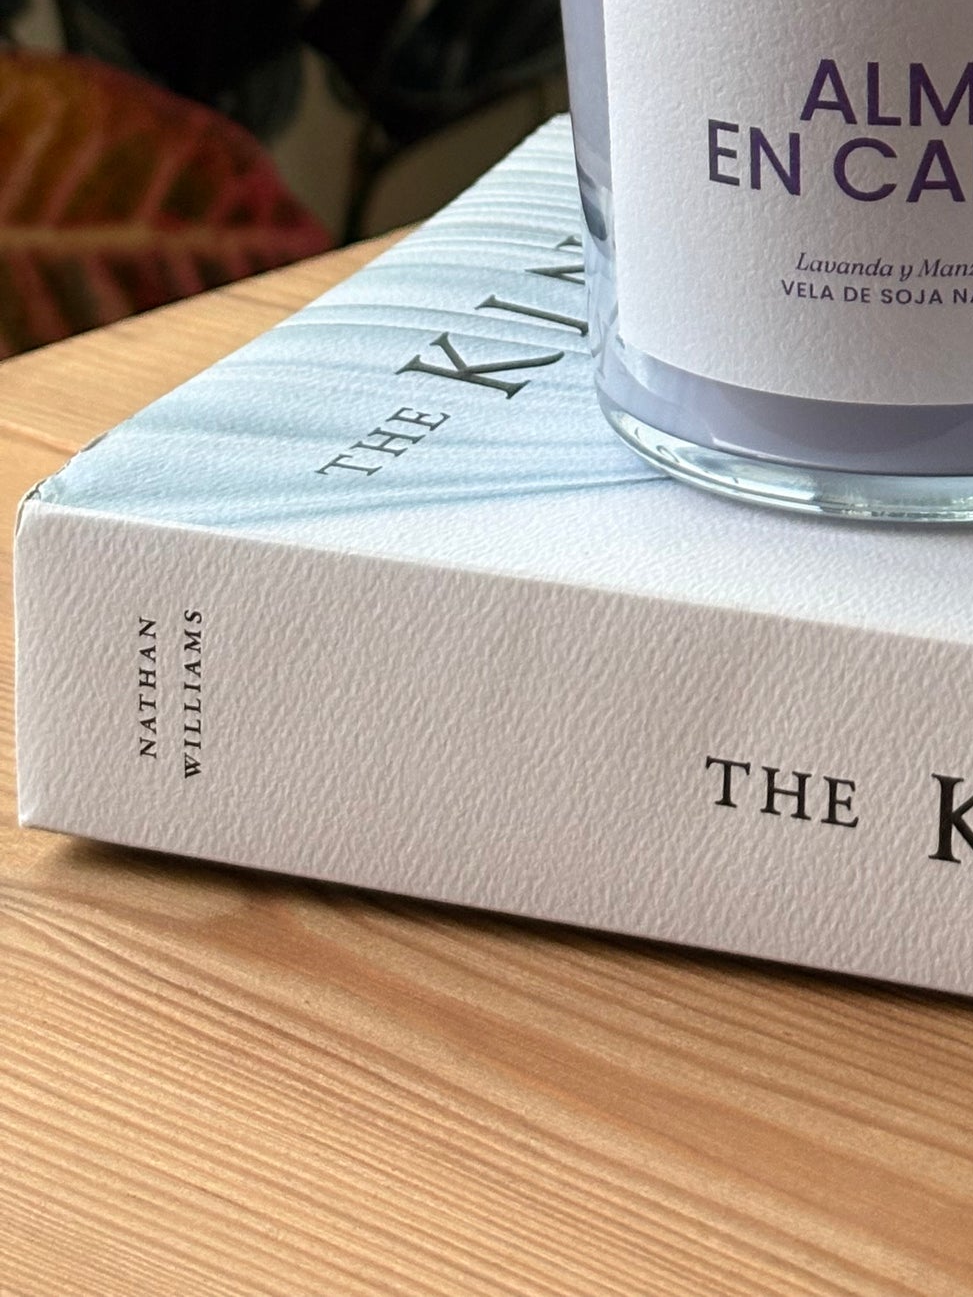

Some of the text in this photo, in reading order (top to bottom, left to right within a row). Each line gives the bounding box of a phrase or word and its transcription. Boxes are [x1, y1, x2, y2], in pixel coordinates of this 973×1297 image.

[708, 118, 801, 196] EN
[781, 279, 834, 301] VELA
[843, 286, 871, 303] DE
[880, 288, 943, 305] SOJA
[795, 252, 893, 277] Lavanda
[899, 262, 913, 282] y
[314, 406, 451, 477] THE
[138, 616, 157, 759] NATHAN
[183, 609, 202, 779] WILLIAMS
[705, 755, 859, 829] THE
